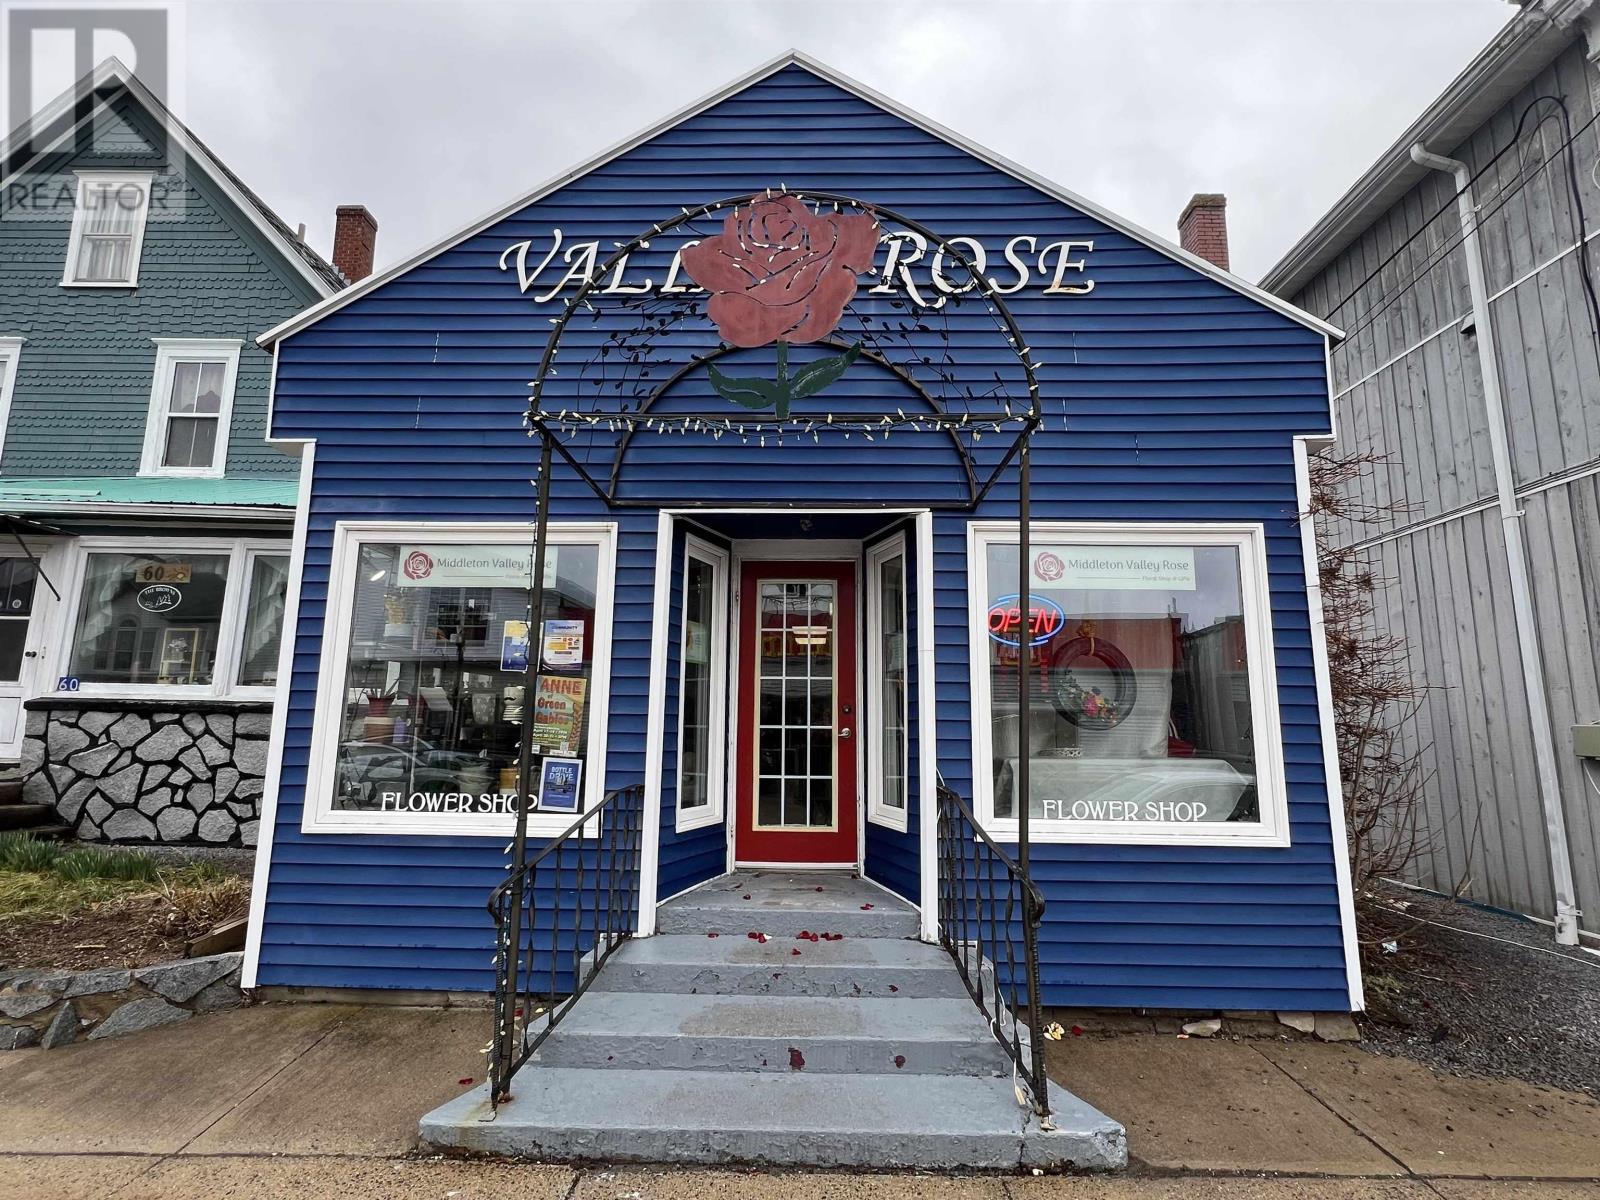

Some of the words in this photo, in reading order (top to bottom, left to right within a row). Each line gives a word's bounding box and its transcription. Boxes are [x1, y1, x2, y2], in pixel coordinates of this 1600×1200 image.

[868, 231, 1095, 309] ROSE
[437, 558, 489, 569] Middleton
[492, 558, 524, 571] Valley
[1068, 559, 1123, 570] Middleton
[1125, 560, 1160, 571] Valley
[1162, 560, 1189, 570] Rose
[143, 565, 165, 581] 60
[59, 678, 78, 691] 60
[541, 678, 582, 696] ANNE
[537, 696, 567, 710] Green
[551, 766, 573, 774] BOTTLE
[381, 792, 474, 813] FLOWER
[1042, 799, 1140, 821] FLOWER
[1145, 801, 1207, 822] SHOP
